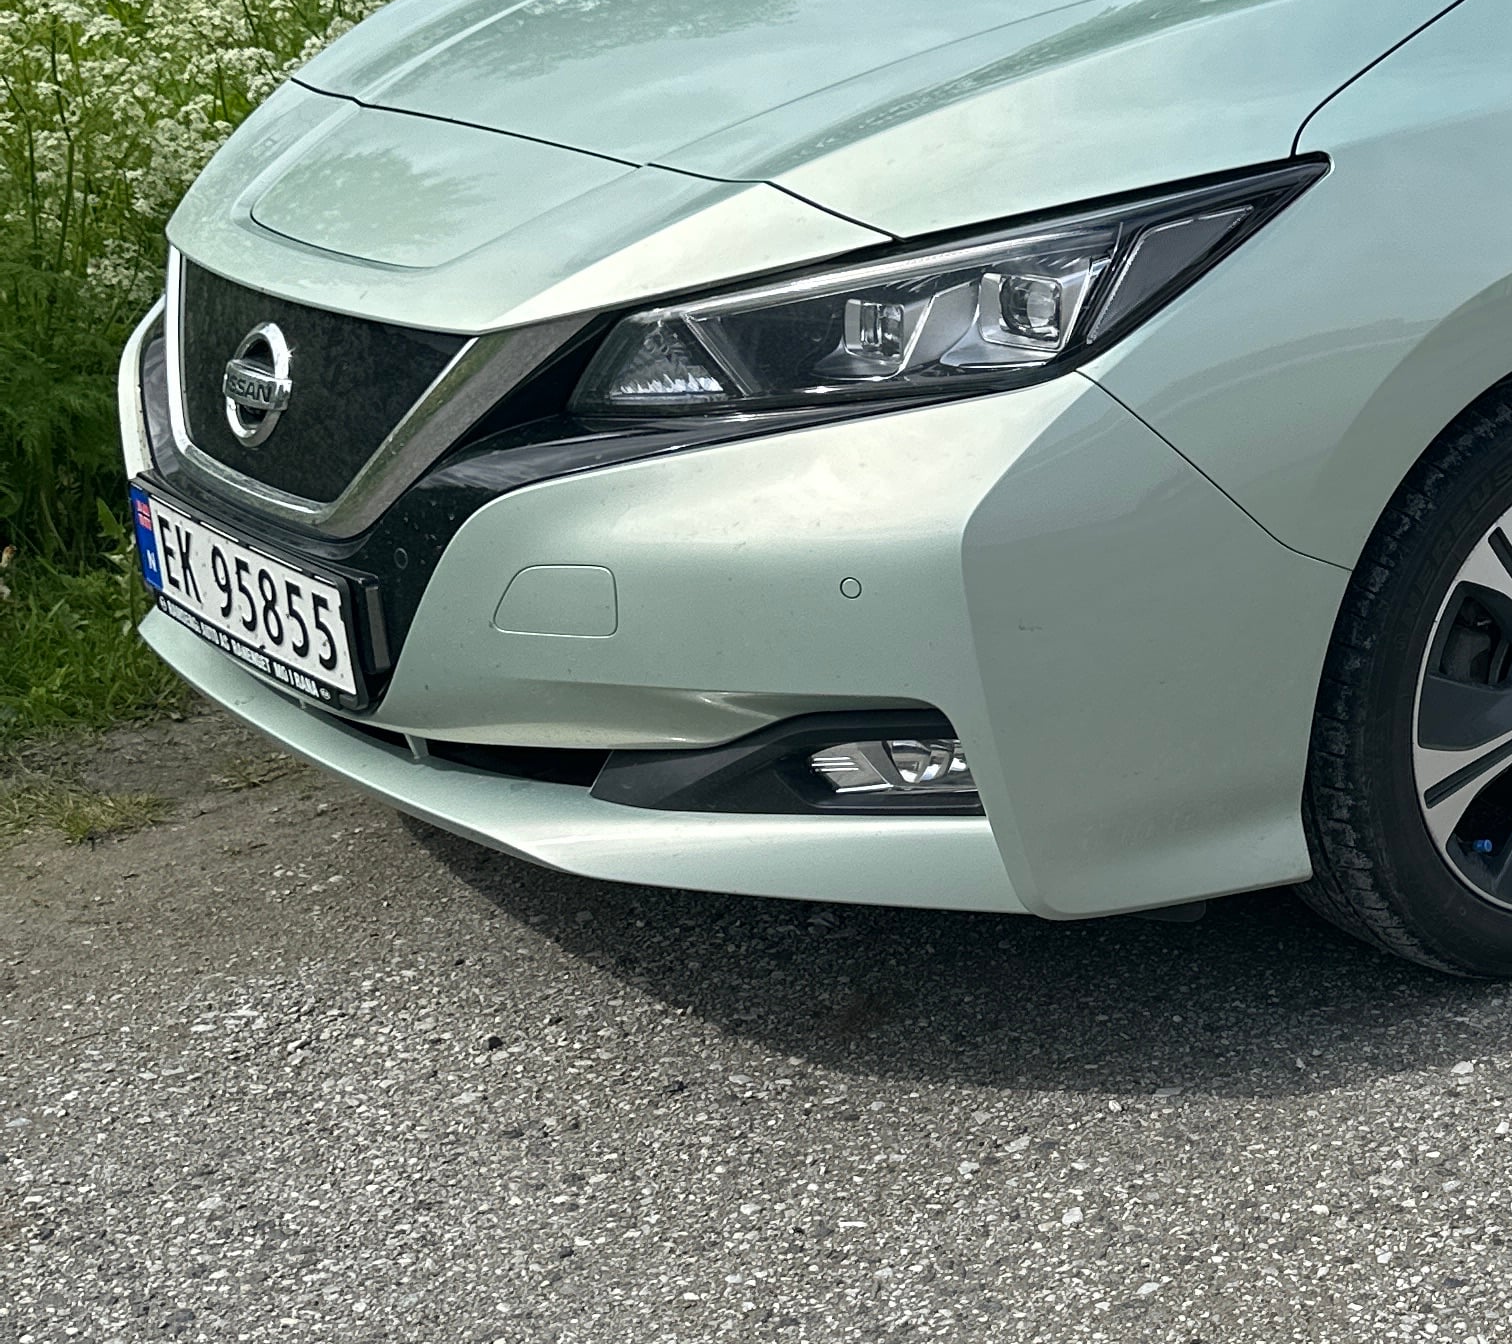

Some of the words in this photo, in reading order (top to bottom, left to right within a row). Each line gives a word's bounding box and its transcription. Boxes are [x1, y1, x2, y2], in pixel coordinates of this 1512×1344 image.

[147, 550, 157, 572] N
[157, 514, 202, 604] EK
[210, 544, 338, 671] 95855
